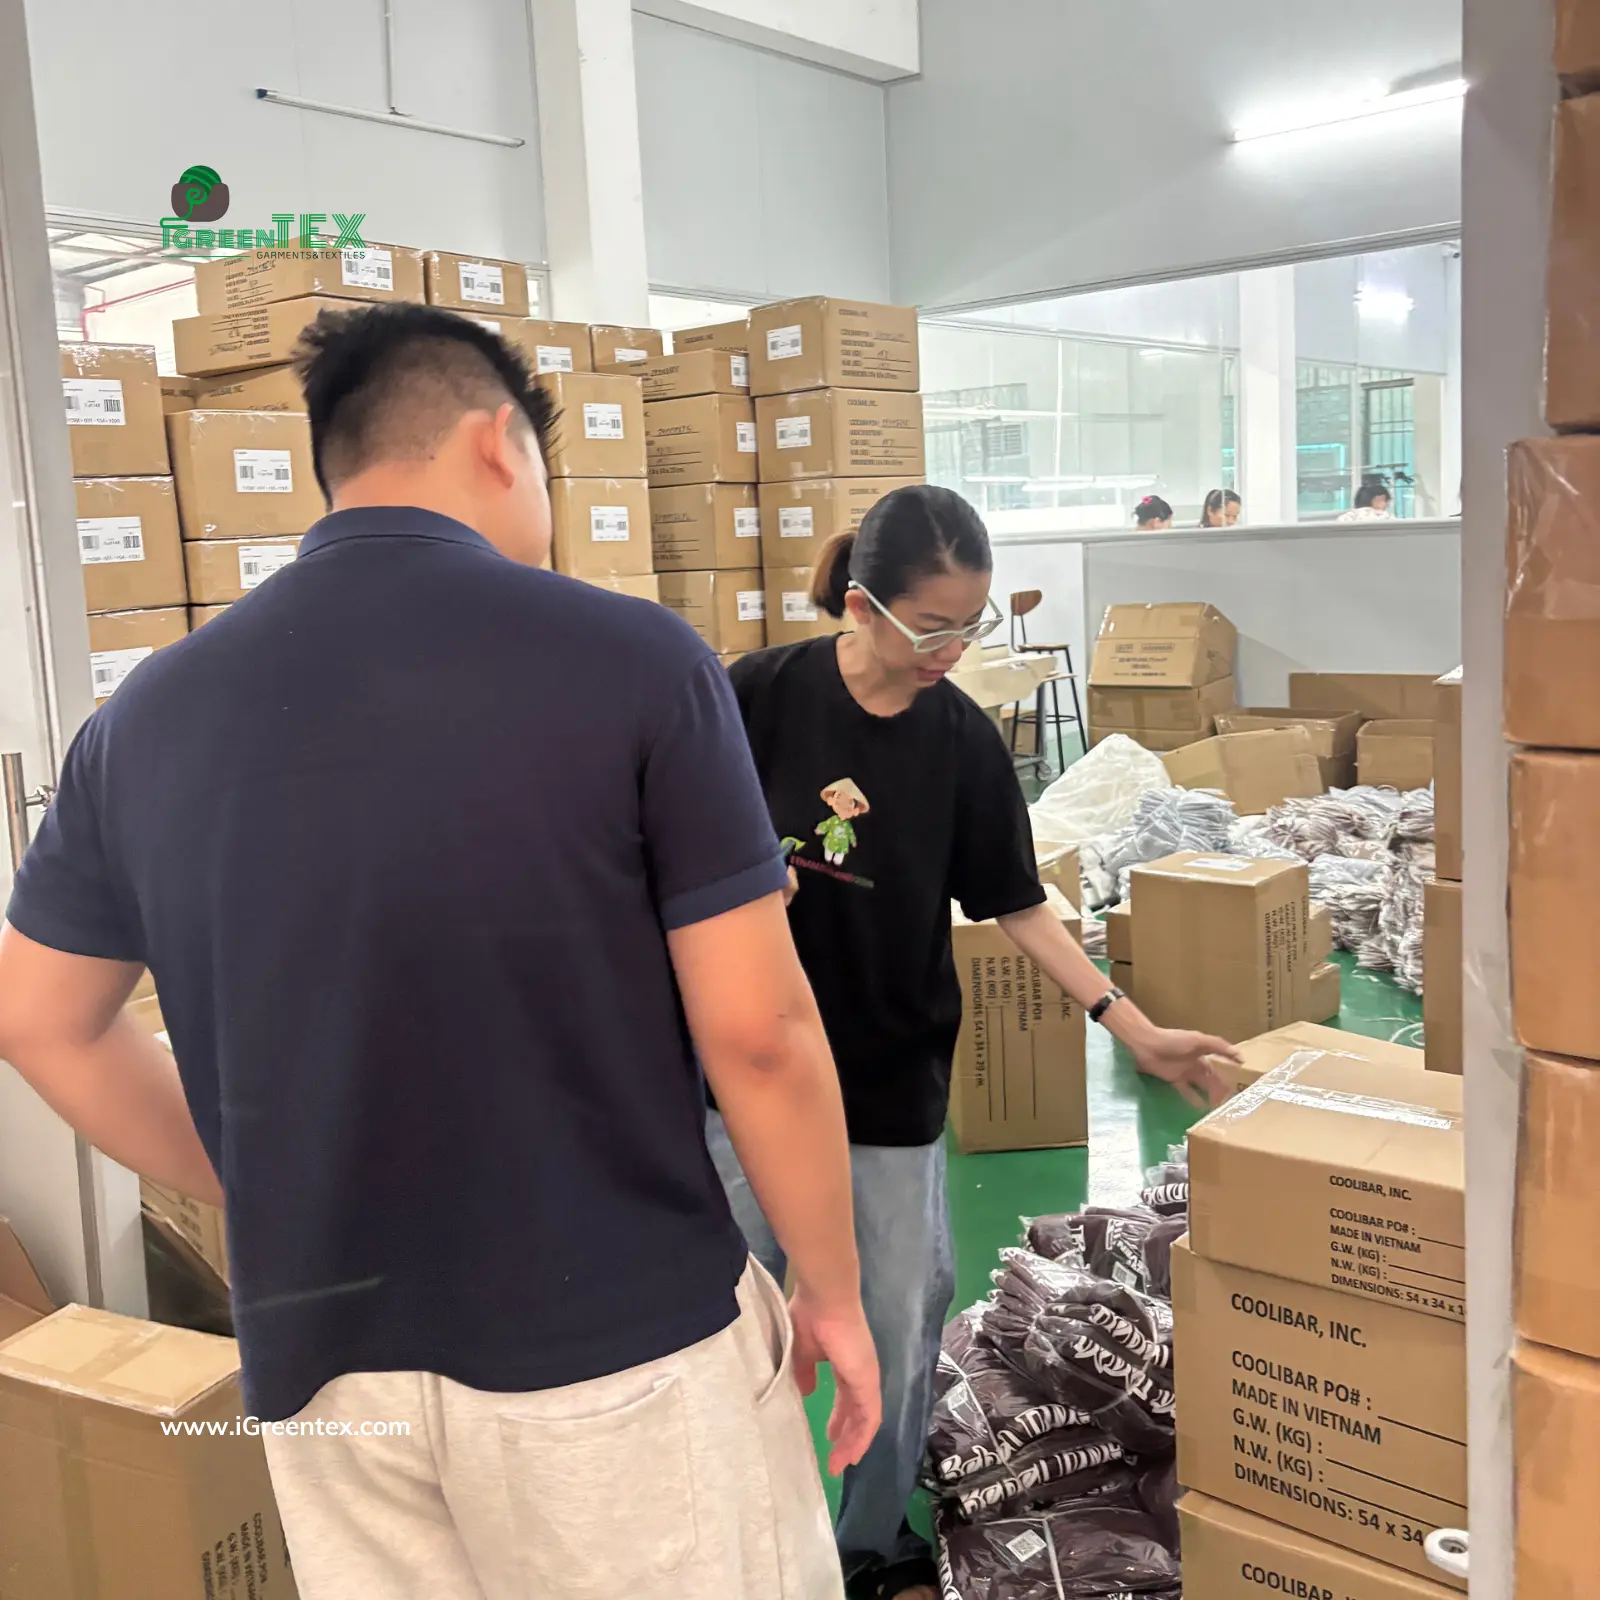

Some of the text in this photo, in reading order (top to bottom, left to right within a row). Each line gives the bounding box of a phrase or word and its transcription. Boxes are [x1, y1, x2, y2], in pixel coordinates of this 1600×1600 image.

[1016, 955, 1028, 1032] MADE IN VIETNAM
[1330, 1175, 1412, 1201] COOLIBAR, INC.
[1330, 1208, 1384, 1228] COOLIBAR
[1387, 1220, 1409, 1233] PO#
[1330, 1224, 1421, 1253] MADE IN VIETNAM
[1330, 1241, 1355, 1255] G.W.
[1357, 1246, 1380, 1263] (KG)
[1331, 1257, 1356, 1272] N.W.
[1358, 1264, 1381, 1279] (KG)
[1331, 1274, 1404, 1299] DIMENSIONS:
[1406, 1291, 1419, 1304] 54
[1422, 1297, 1428, 1305] x
[1431, 1298, 1446, 1310] 34
[1448, 1304, 1455, 1312] x
[1231, 1293, 1367, 1348] COOLIBAR, INC.
[1232, 1350, 1318, 1393] COOLIBAR
[1324, 1379, 1361, 1406] PO#
[1232, 1378, 1381, 1445] MADE IN VIETNAM
[1233, 1408, 1270, 1435] G.W.
[1276, 1421, 1312, 1454] (KG)
[1233, 1434, 1272, 1464] N.W.
[1277, 1450, 1313, 1483] (KG)
[1234, 1462, 1424, 1546] DIMENSIONS: 54 x 34
